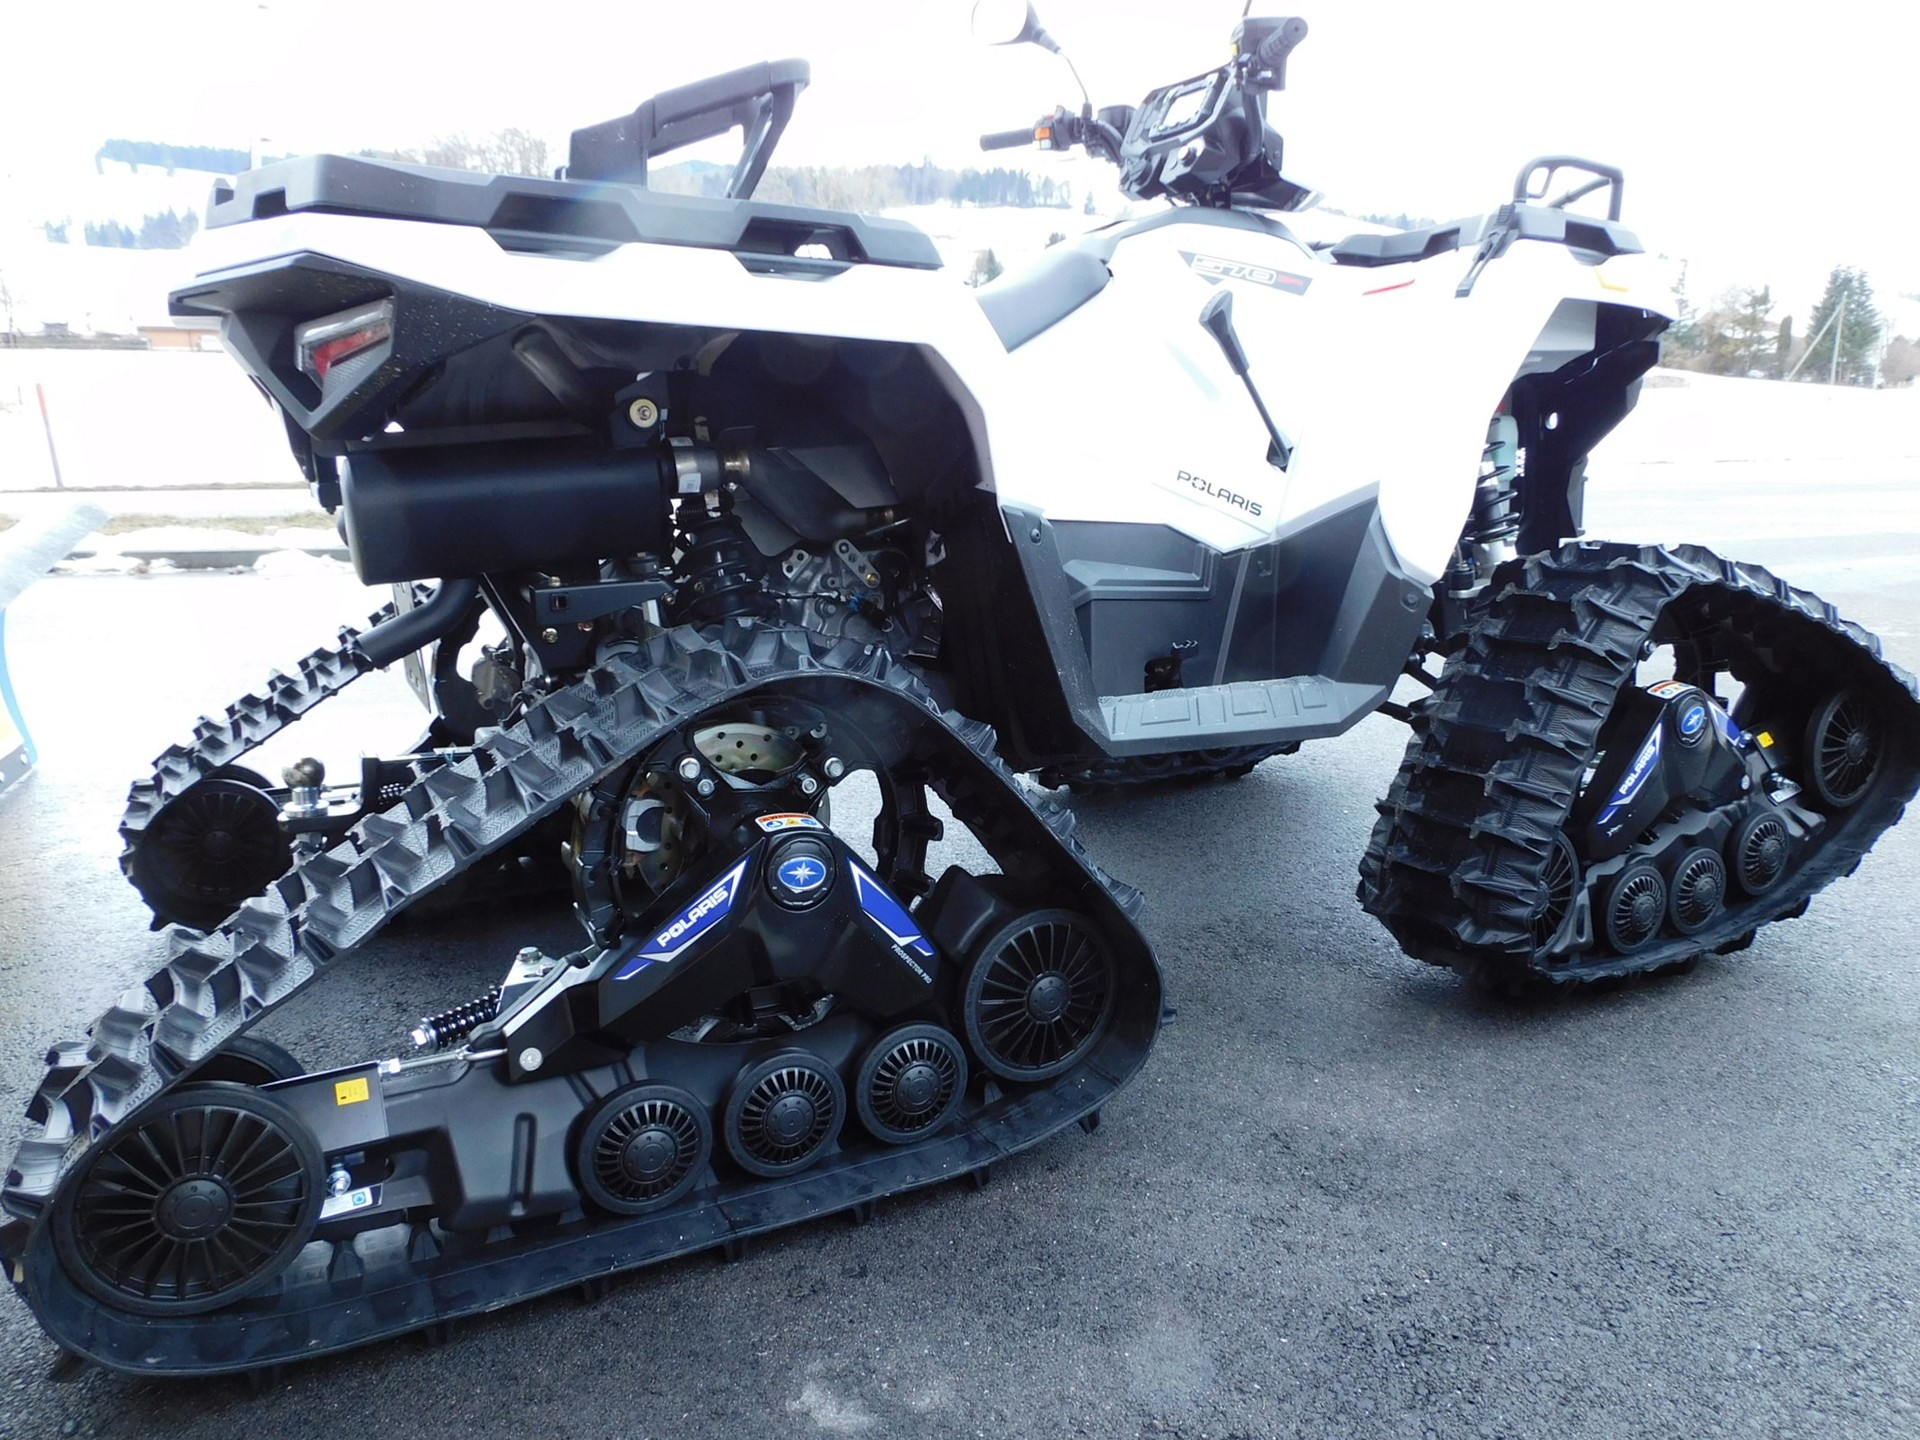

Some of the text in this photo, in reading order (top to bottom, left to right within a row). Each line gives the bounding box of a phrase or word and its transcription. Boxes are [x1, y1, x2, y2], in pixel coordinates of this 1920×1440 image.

[1176, 470, 1262, 516] POLARIS
[1619, 744, 1656, 795] POLARIS
[656, 886, 729, 947] POLARIS
[891, 944, 933, 984] PROSPECTOR PRO
